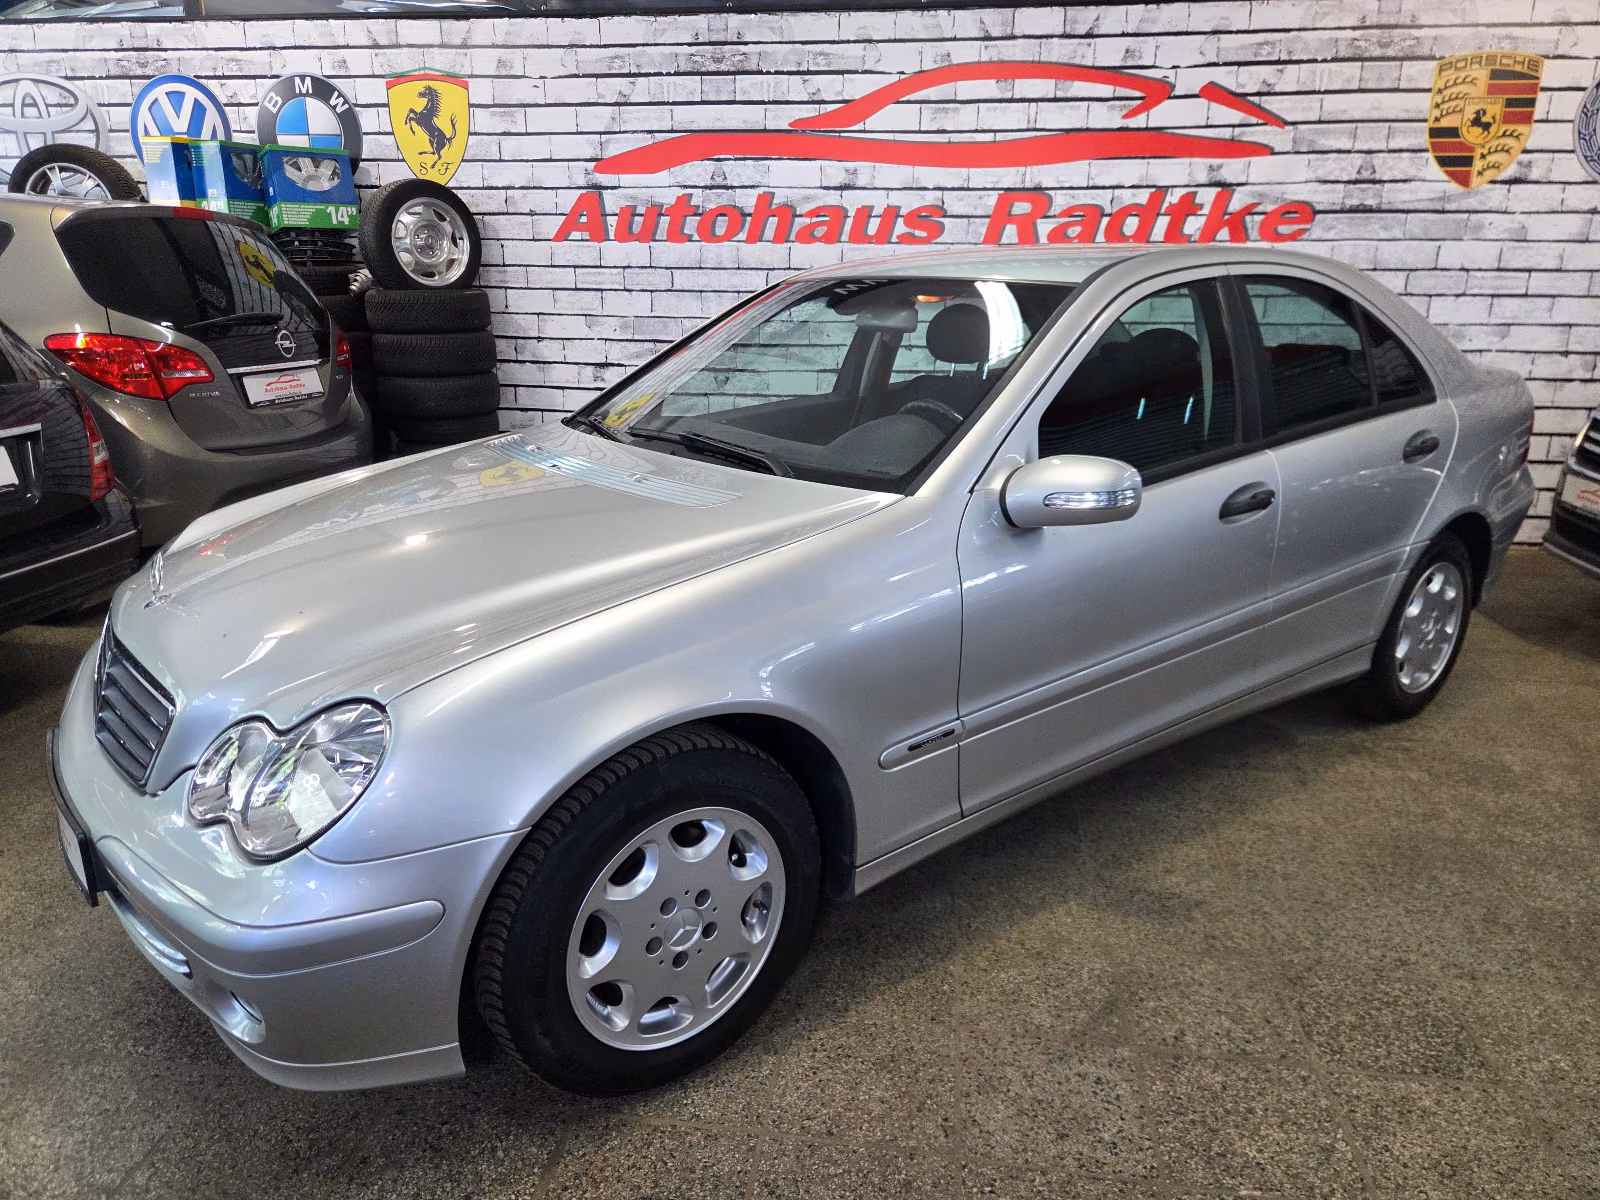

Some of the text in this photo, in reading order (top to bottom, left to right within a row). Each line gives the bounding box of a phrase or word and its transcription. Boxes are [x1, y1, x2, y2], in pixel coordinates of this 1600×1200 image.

[1438, 54, 1541, 76] PORSCHE
[263, 76, 350, 114] BMW
[419, 161, 429, 176] S
[552, 188, 1316, 246] Autohaus Radtke
